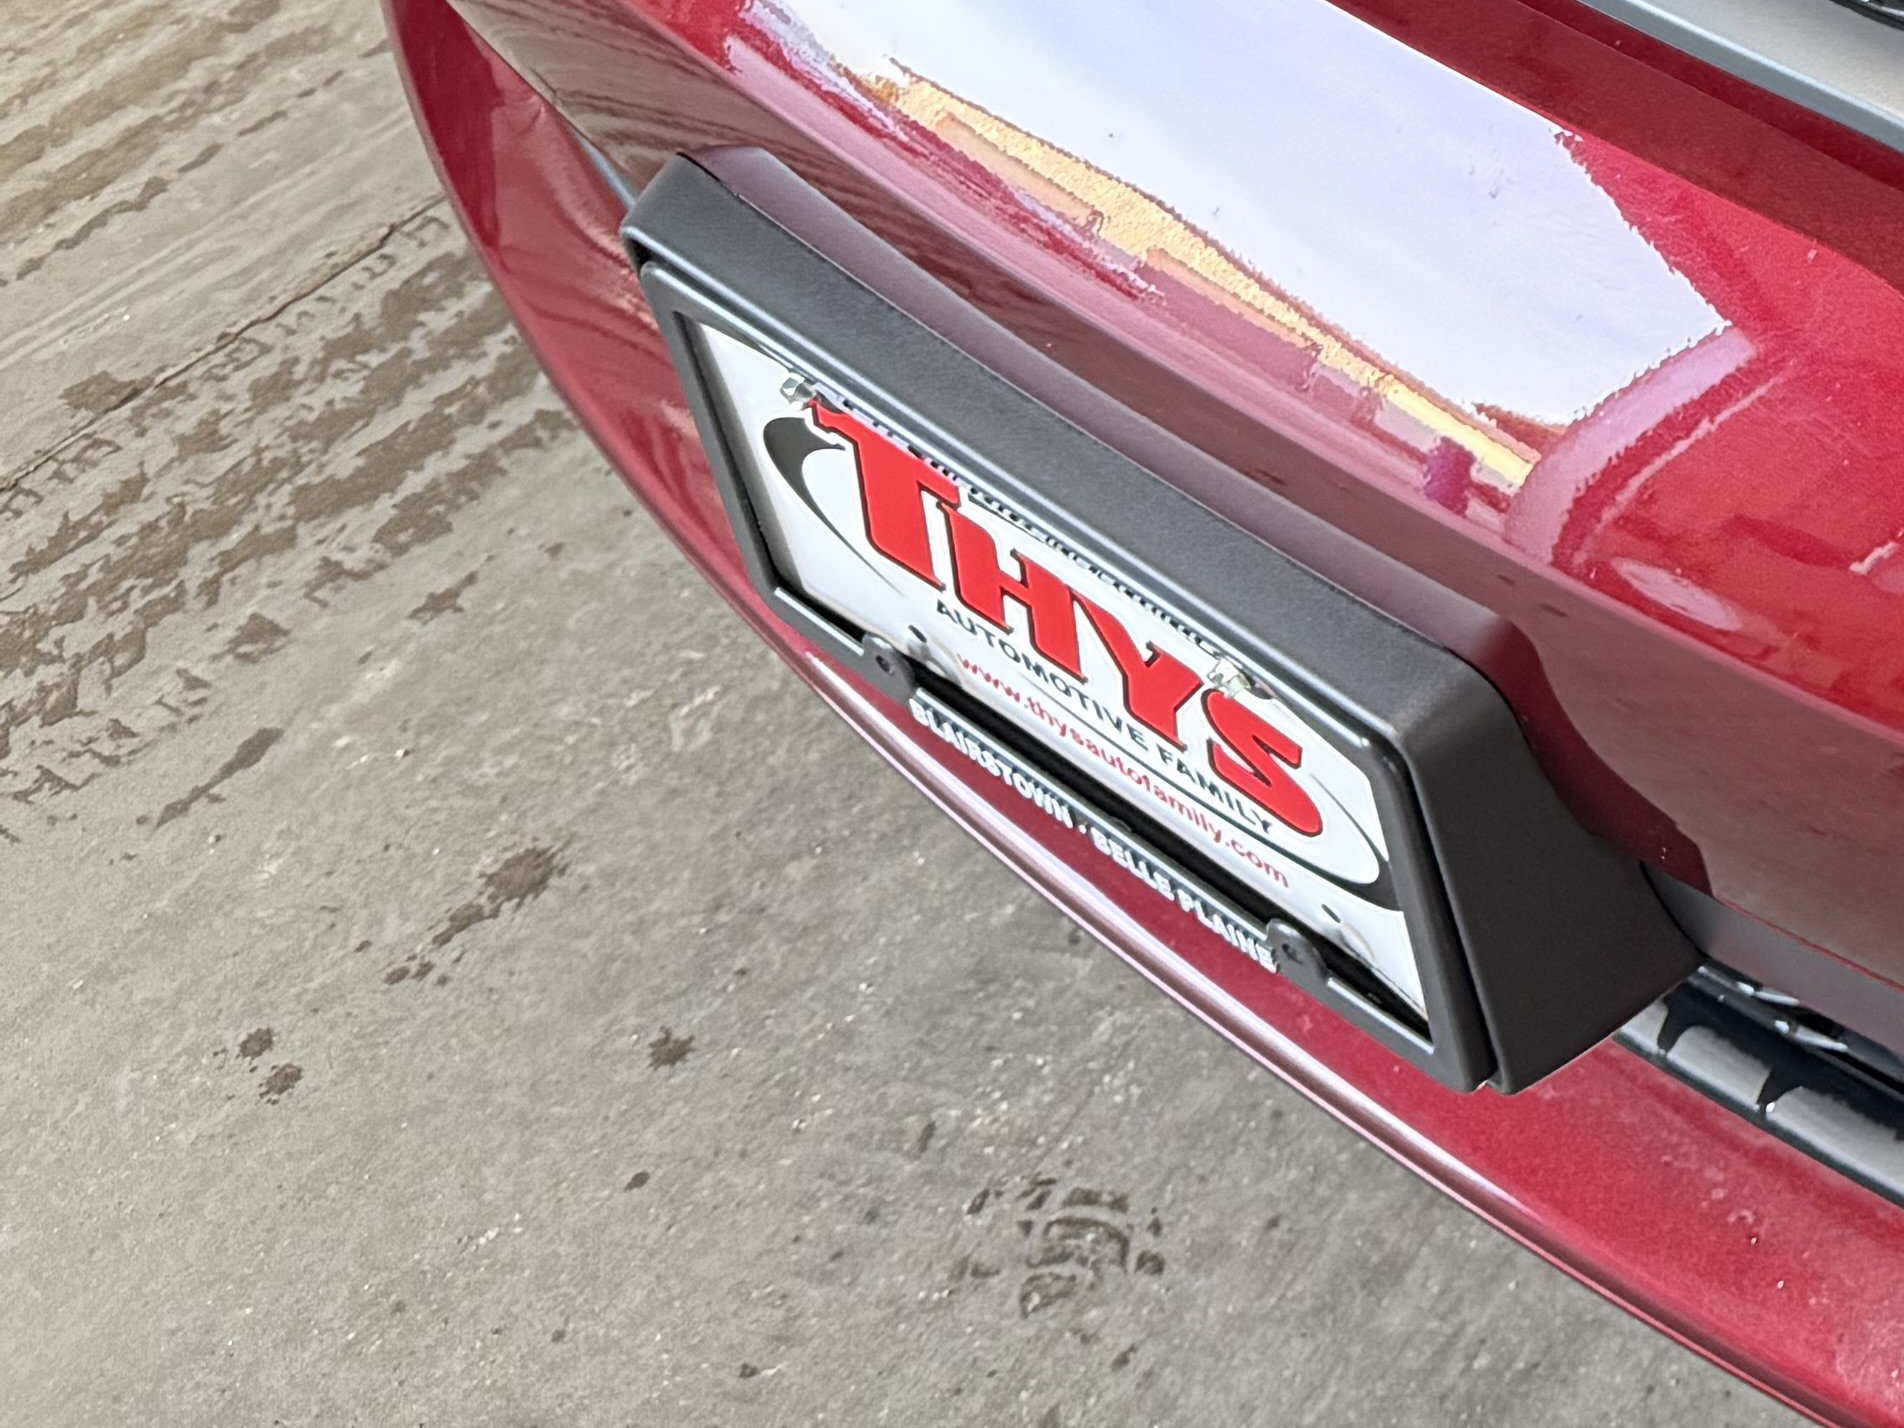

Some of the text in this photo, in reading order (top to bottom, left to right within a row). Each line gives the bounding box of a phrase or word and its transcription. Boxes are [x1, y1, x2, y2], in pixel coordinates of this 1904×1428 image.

[807, 398, 1323, 836] THYS
[936, 598, 1272, 834] AUTOMOTIVE FAMILY
[908, 697, 1280, 974] BLAIRSTOWN BELLE PLAINE
[956, 653, 1290, 889] www.thysautofamily.com
